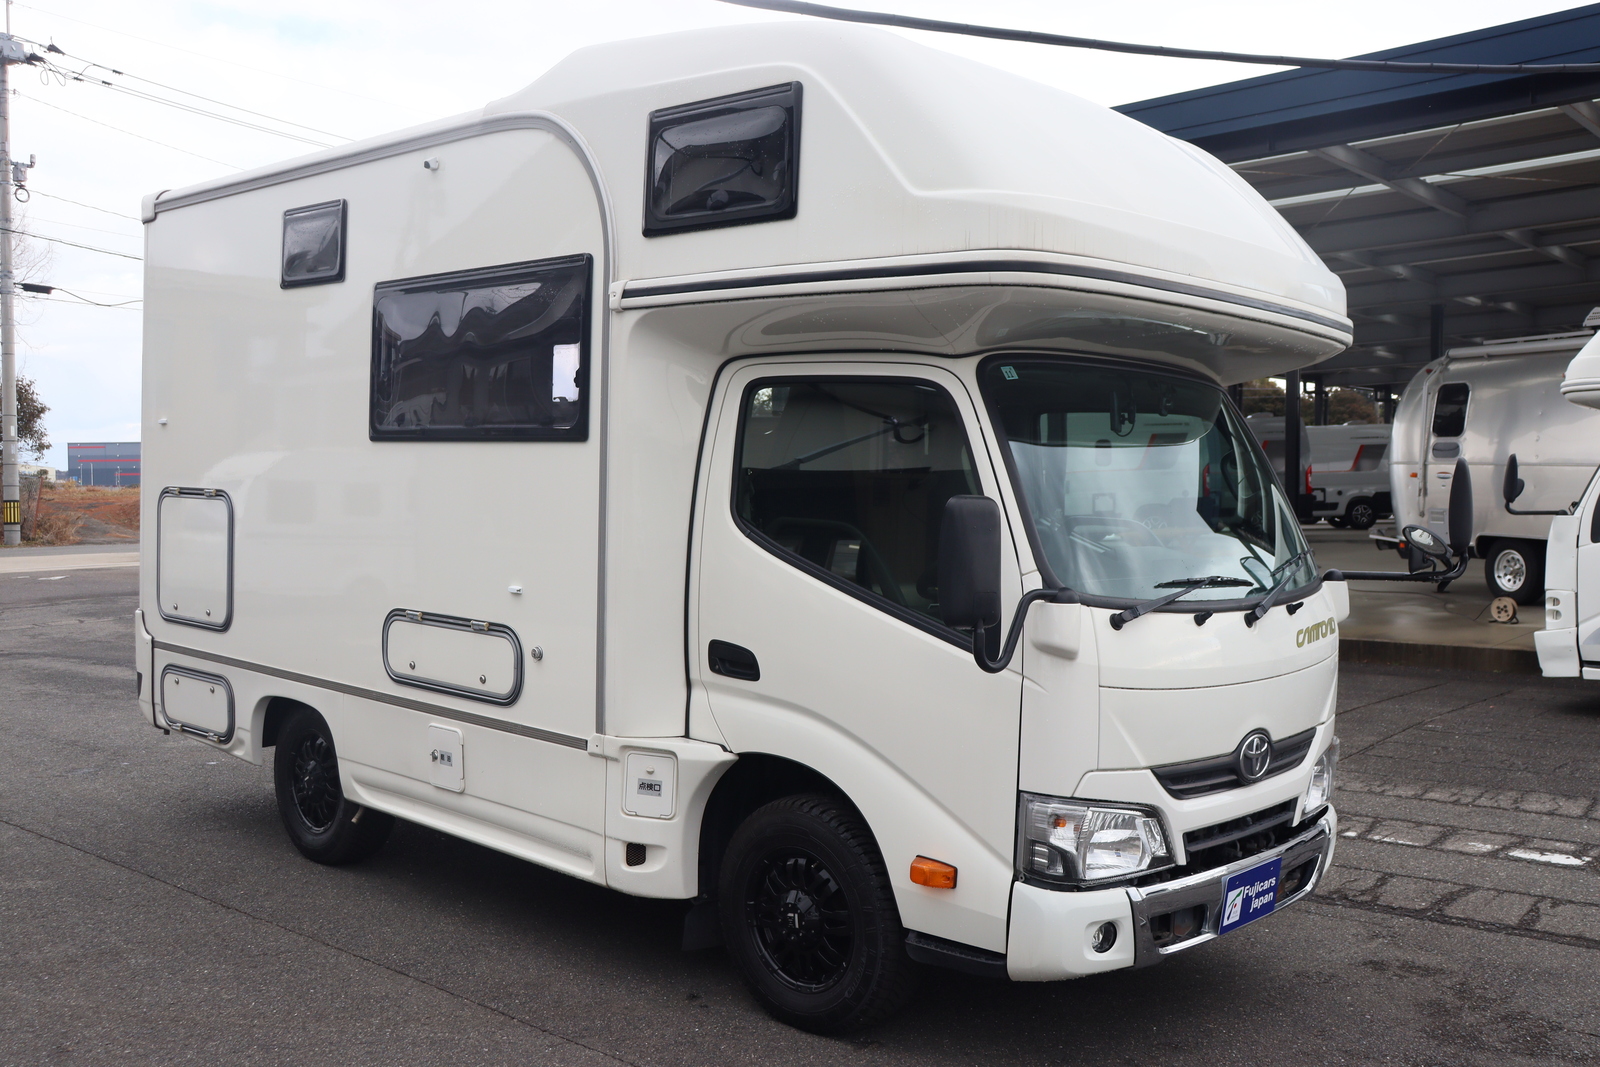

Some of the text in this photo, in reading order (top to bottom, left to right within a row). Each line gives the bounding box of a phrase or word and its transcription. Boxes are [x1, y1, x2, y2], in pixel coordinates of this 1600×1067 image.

[638, 781, 661, 792] 点検口
[1243, 877, 1276, 899] Fujicars
[1249, 892, 1274, 913] japan
